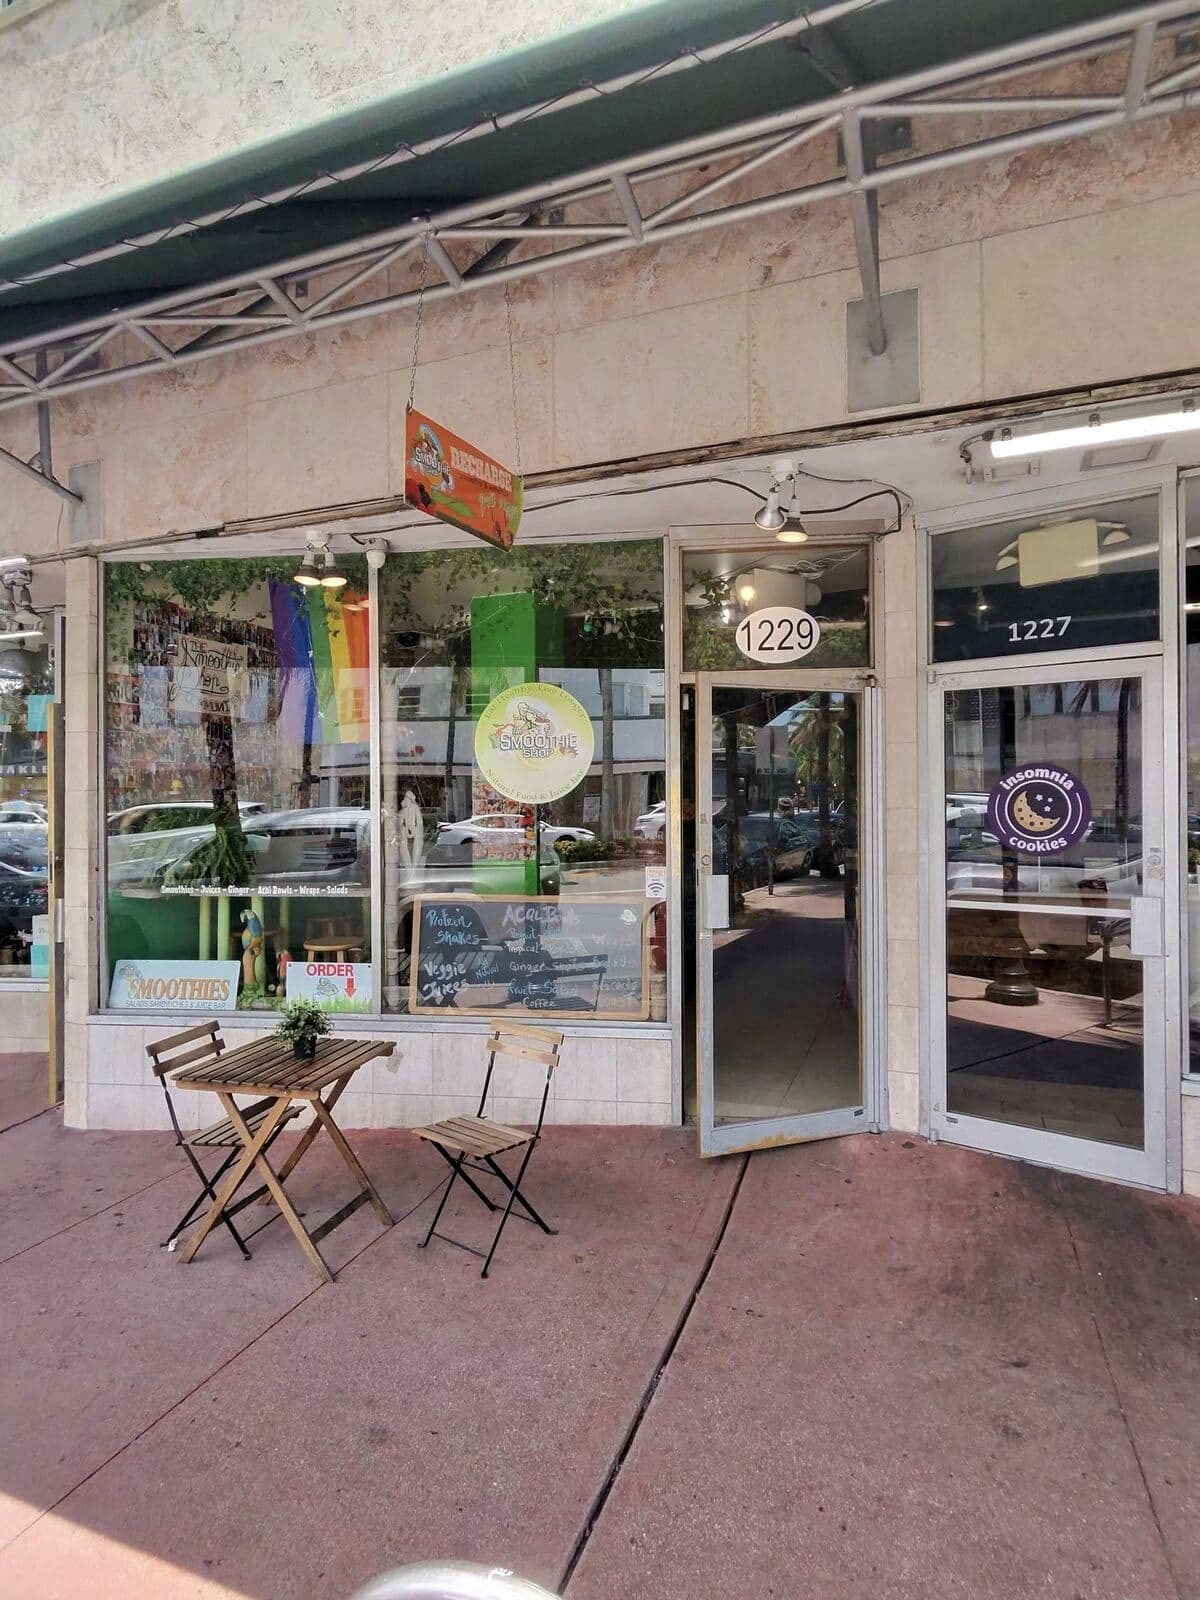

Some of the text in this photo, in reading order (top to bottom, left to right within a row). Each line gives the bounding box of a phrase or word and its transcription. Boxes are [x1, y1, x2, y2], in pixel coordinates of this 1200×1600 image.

[450, 446, 512, 493] RECHARGE
[741, 618, 814, 652] 1229
[1008, 616, 1073, 642] 1227
[500, 732, 577, 751] SMOOTHIE
[523, 748, 554, 758] SHOP
[486, 768, 514, 795] Natural
[516, 791, 538, 801] Food
[550, 784, 568, 799] Juice
[570, 768, 584, 784] Bar
[1000, 768, 1074, 791] insomnia
[1009, 836, 1068, 852] cookies
[160, 884, 194, 894] Smoothies
[201, 884, 221, 894] Juices
[228, 884, 250, 896] Ginger
[273, 885, 293, 894] Bowls
[300, 885, 320, 896] Wraps
[327, 885, 348, 894] Salads
[426, 909, 472, 927] Protein
[434, 930, 481, 945] Shakes
[306, 963, 354, 977] ORDER
[424, 960, 466, 980] Veggie
[509, 961, 545, 976] Ginger
[128, 978, 231, 1001] SMOOTHIES
[523, 997, 557, 1008] Coffee
